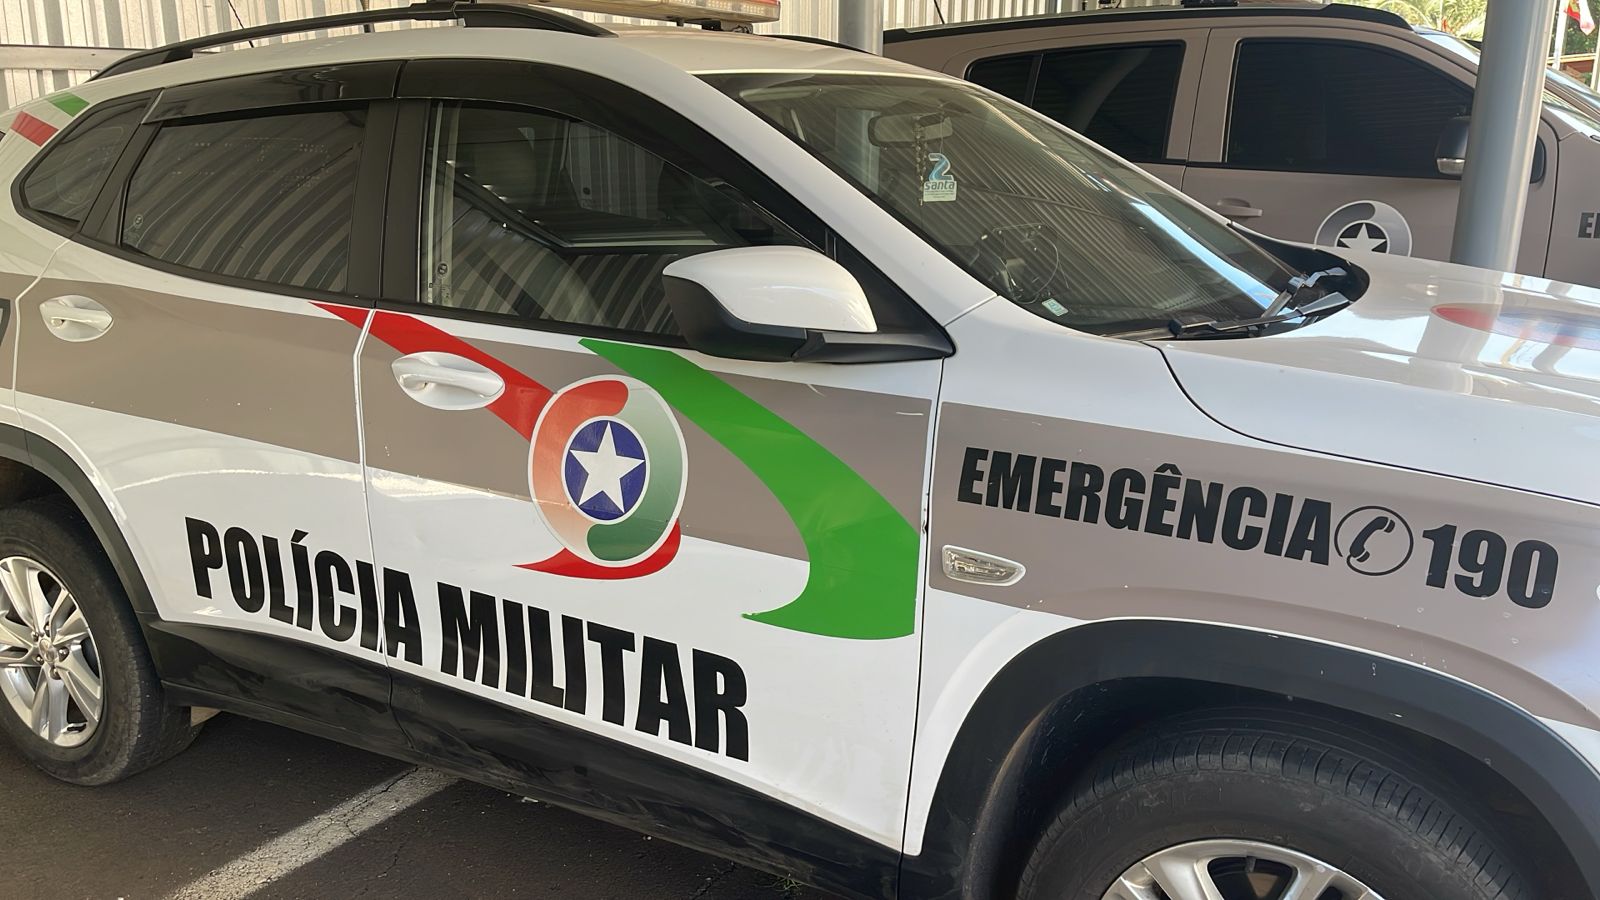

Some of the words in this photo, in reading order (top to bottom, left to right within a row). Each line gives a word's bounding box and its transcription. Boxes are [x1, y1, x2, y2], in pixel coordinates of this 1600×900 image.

[924, 181, 955, 190] santa
[1578, 212, 1600, 239] E
[957, 446, 1333, 566] EMERGÊNCIA
[1421, 522, 1559, 609] 190
[185, 516, 424, 667] POLÍCIA
[436, 581, 750, 763] MILITAR
